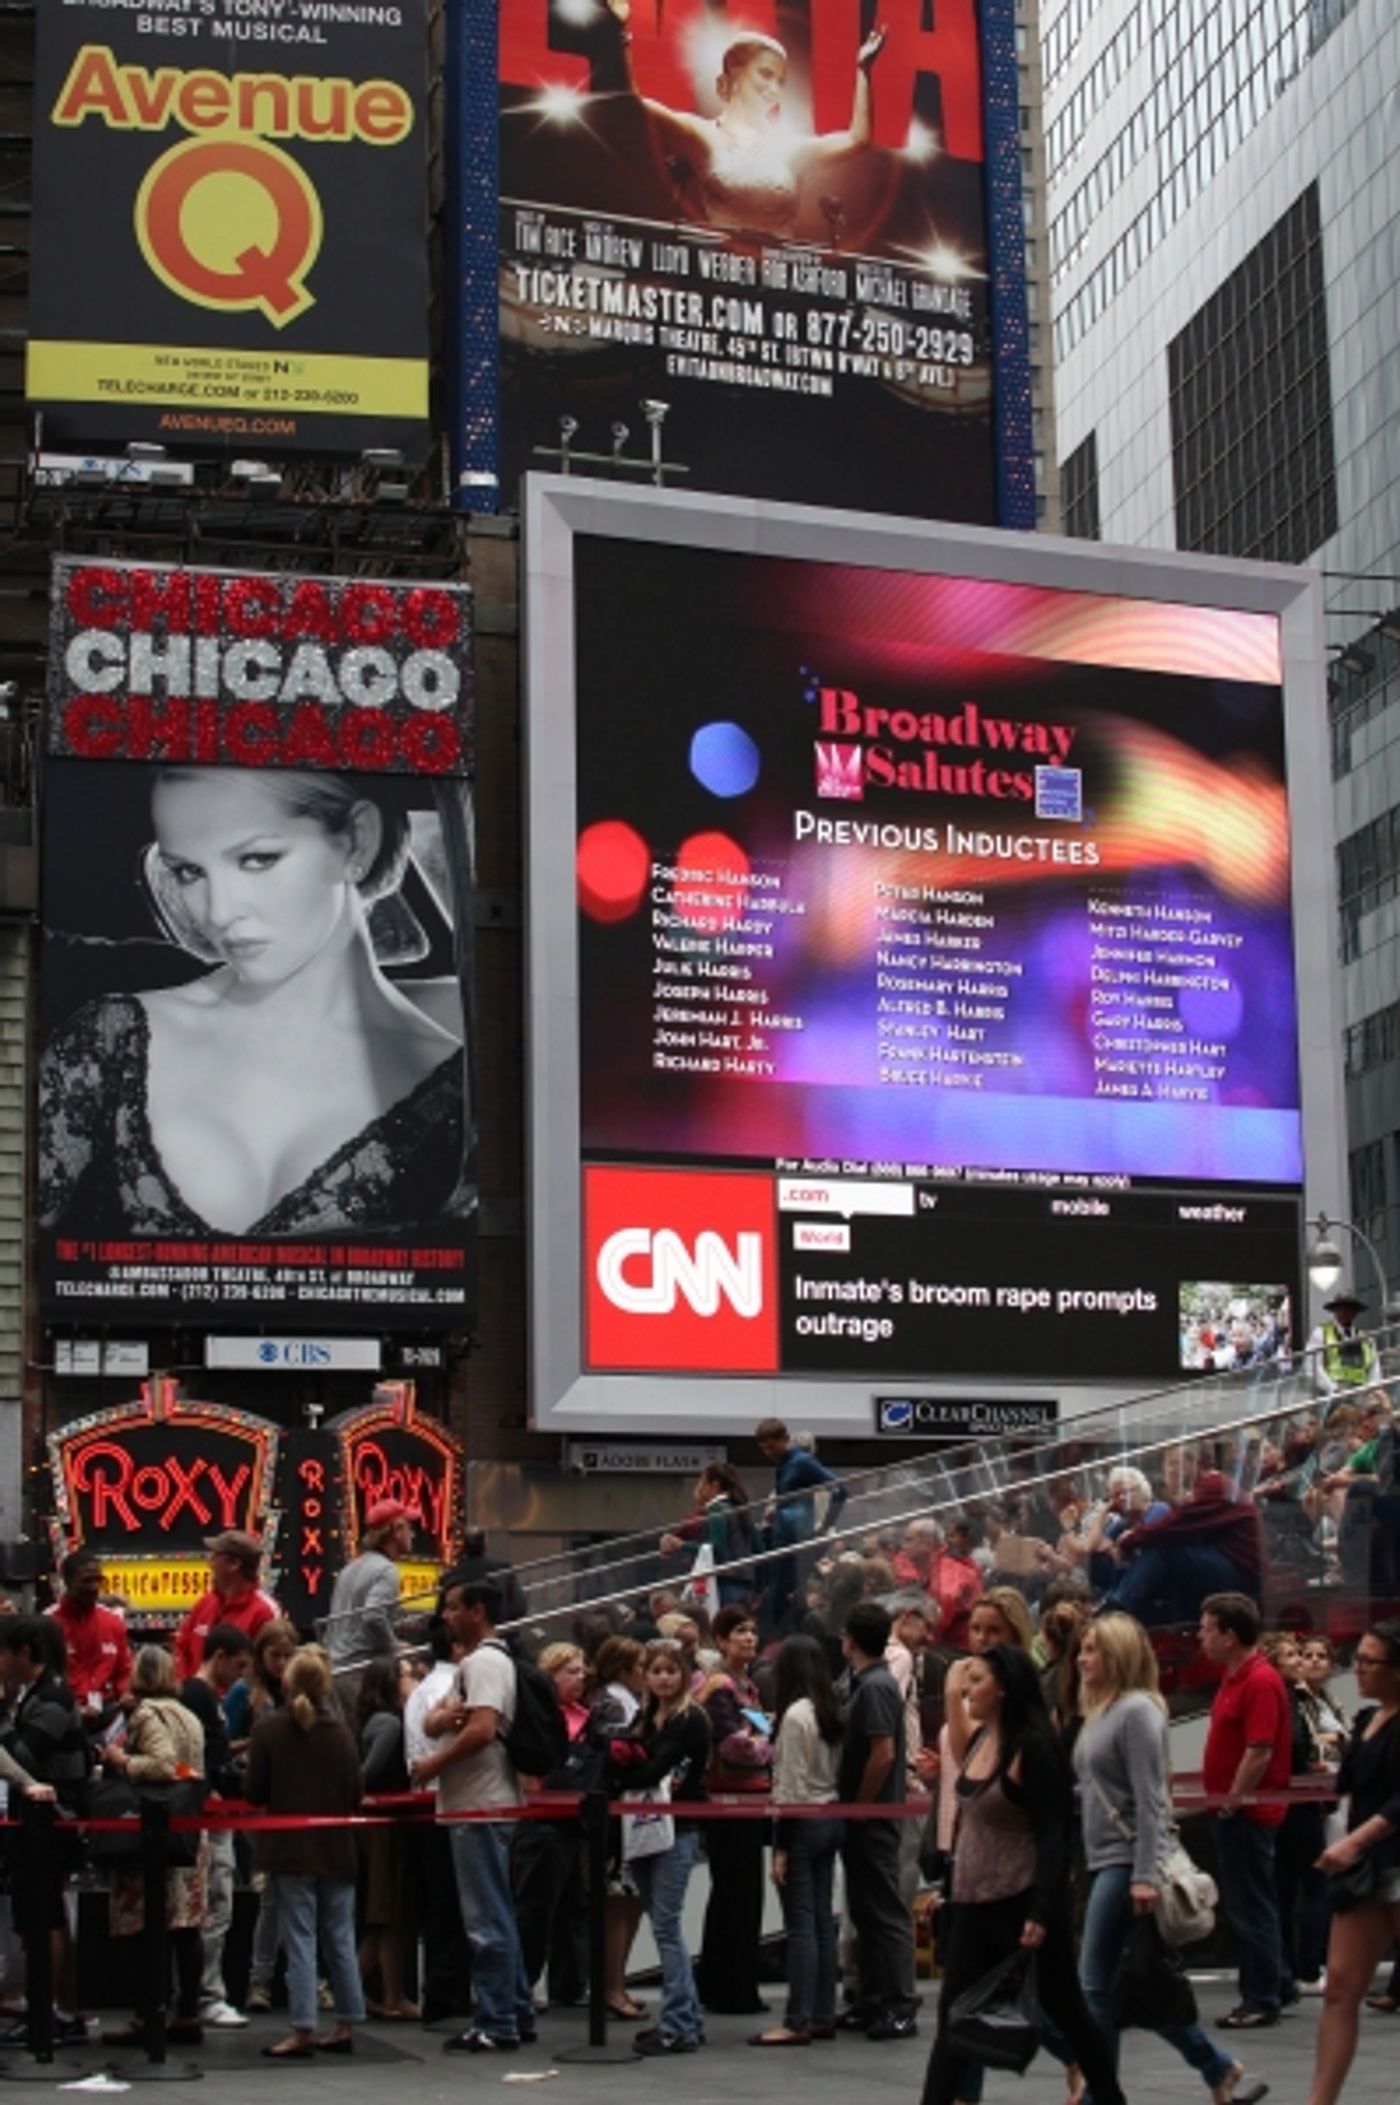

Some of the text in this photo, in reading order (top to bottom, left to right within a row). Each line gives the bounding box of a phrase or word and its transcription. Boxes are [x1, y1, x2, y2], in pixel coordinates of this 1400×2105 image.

[137, 14, 328, 44] BEST MUSICAL
[51, 44, 414, 146] Avenue
[134, 133, 324, 331] Q
[515, 265, 974, 367] TICKETMASTER.COM OR 877-250-2929
[66, 565, 462, 649] CHICAGO
[65, 627, 462, 712] CHICAGO
[62, 692, 461, 775] CHICAGO
[820, 687, 1079, 767] Broadway
[864, 744, 1035, 801] Salutes
[794, 810, 1101, 866] PREVIOUS INDUCTEES
[782, 1187, 830, 1203] .com
[918, 1191, 938, 1209] tv
[1051, 1196, 1110, 1216] mobile
[1178, 1203, 1247, 1223] weather
[799, 1230, 844, 1247] World
[596, 1226, 764, 1319] CNN
[794, 1274, 1158, 1316] Inmate's broom rape prompts
[282, 1343, 332, 1366] CBS
[794, 1311, 894, 1342] outrage
[71, 1441, 251, 1531] ROXY
[298, 1457, 327, 1596] ROXY
